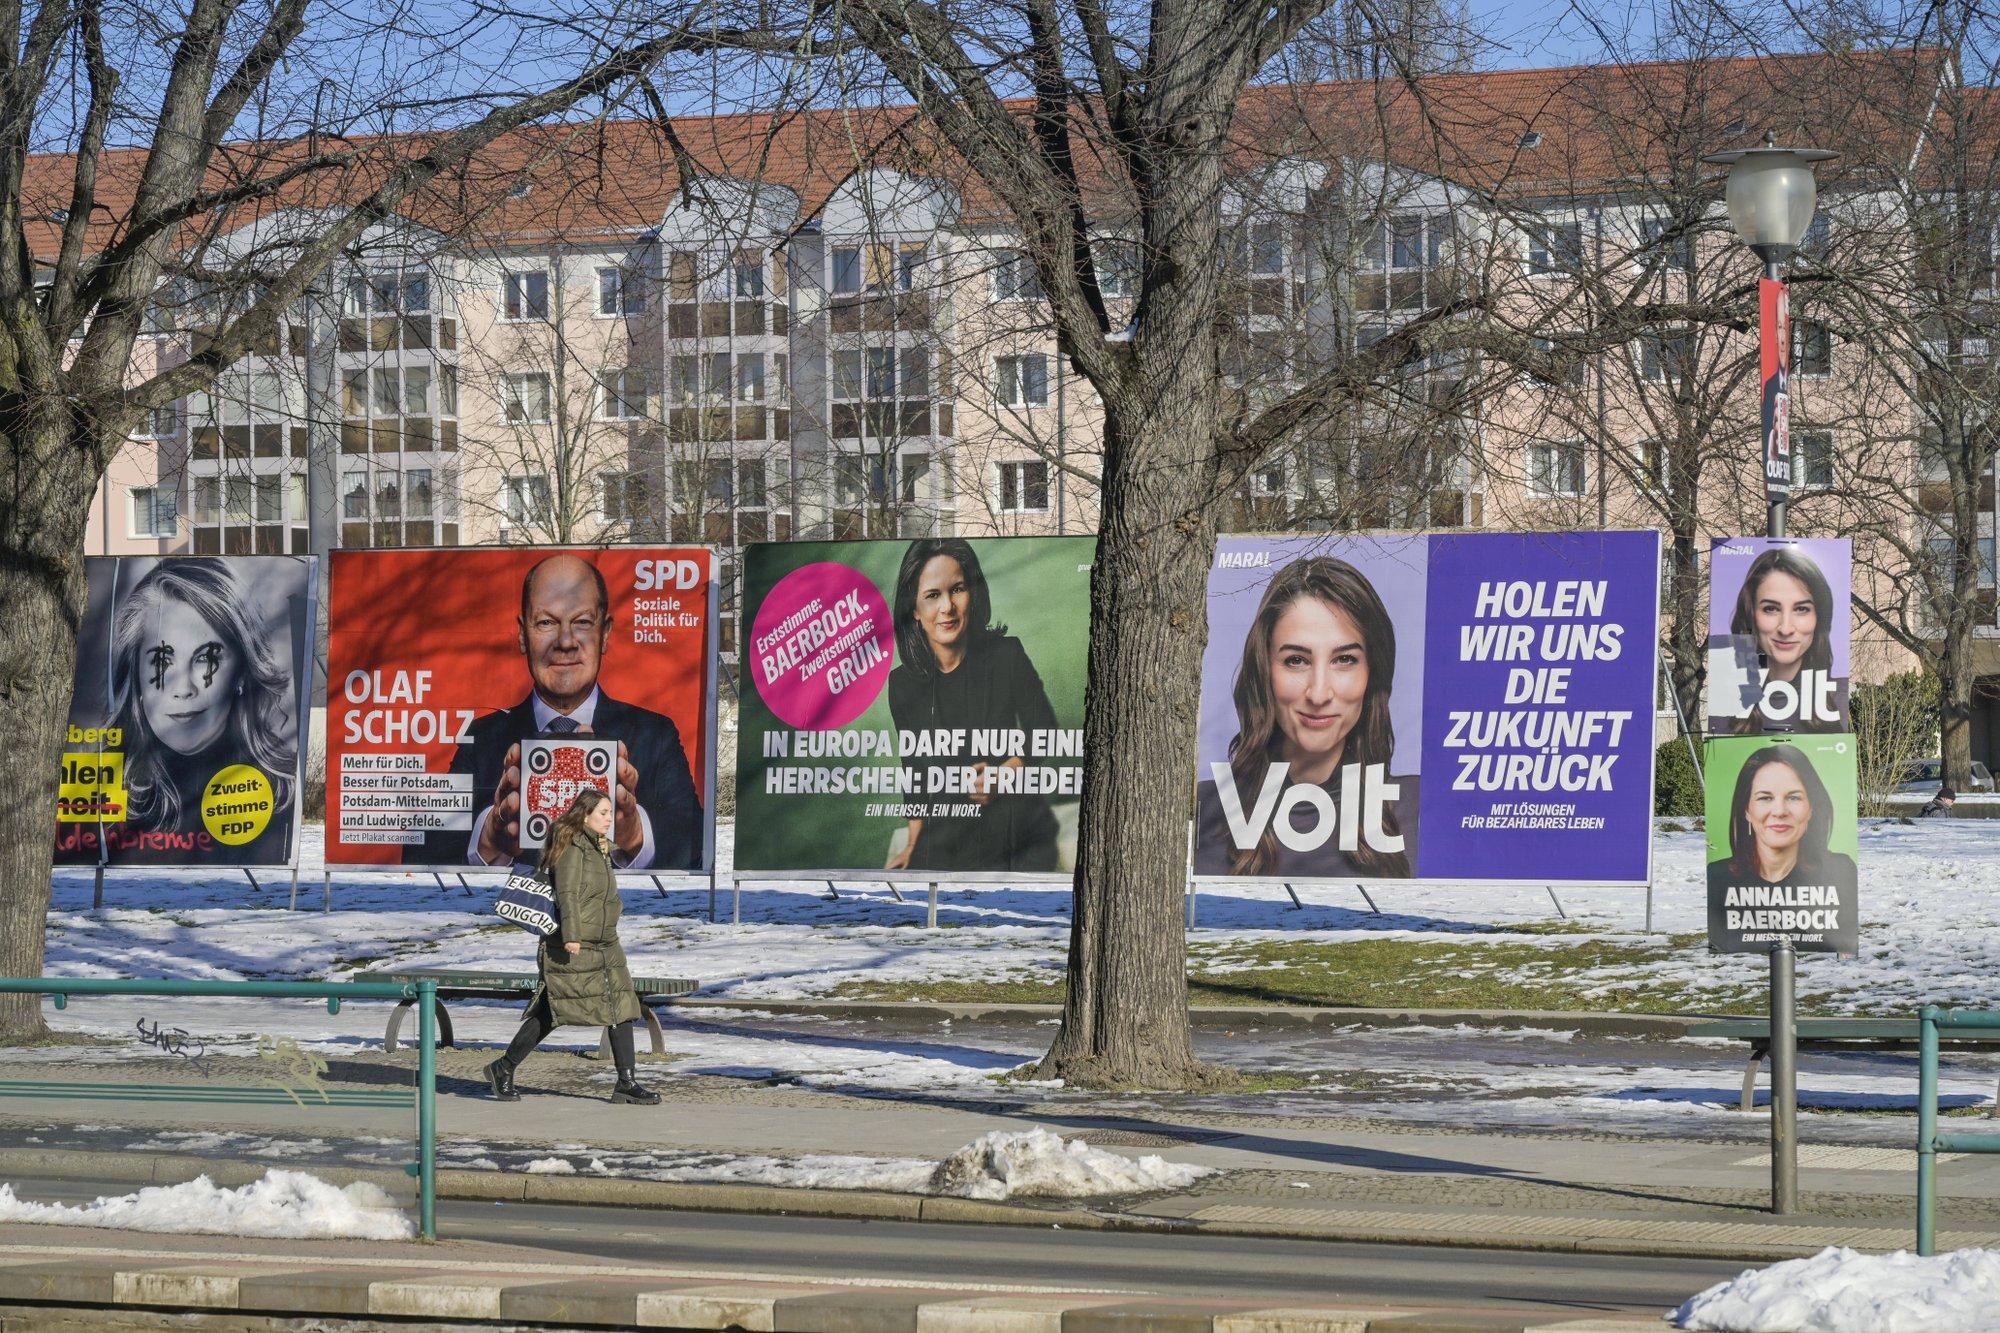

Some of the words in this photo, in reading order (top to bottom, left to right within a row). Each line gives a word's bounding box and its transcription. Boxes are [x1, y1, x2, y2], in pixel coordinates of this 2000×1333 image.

[1720, 545, 1754, 555] MARAL
[634, 560, 700, 591] SPD
[634, 597, 681, 611] Soziale
[1475, 580, 1608, 618] HOLEN
[634, 613, 676, 627] Politik
[679, 612, 699, 627] für
[756, 598, 823, 655] Erststimme:
[634, 629, 667, 643] Dich.
[762, 587, 870, 685] BAERBOCK.
[1460, 625, 1535, 661] WIR
[1540, 623, 1625, 661] UNS
[798, 618, 875, 682] Zweitstimme:
[826, 635, 889, 695] GRÜN.
[344, 669, 432, 704] OLAF
[1504, 668, 1571, 704] DIE
[344, 709, 475, 744] SCHOLZ
[1443, 711, 1633, 748] ZUKUNFT
[763, 731, 788, 757] IN
[794, 730, 893, 757] EUROPA
[900, 729, 965, 756] DARF
[971, 728, 1026, 757] NUR
[343, 757, 373, 769] Mehr
[376, 756, 393, 769] für
[395, 757, 423, 769] Dich.
[1452, 747, 1620, 792] ZURÜCK
[211, 779, 262, 796] Zweit-
[343, 776, 380, 788] Besser
[382, 776, 399, 788] für
[400, 777, 453, 790] Potsdam,
[765, 766, 922, 794] HERRSCHEN:
[927, 766, 979, 794] DER
[206, 801, 269, 817] stimme
[342, 795, 460, 808] Potsdam-Mittelmark
[462, 797, 469, 808] II
[865, 804, 883, 817] EIN
[884, 804, 930, 817] MENSCH.
[931, 804, 949, 817] EIN
[951, 804, 982, 817] WORT.
[1210, 761, 1406, 854] Volt
[1491, 804, 1513, 816] MIT
[1513, 802, 1576, 816] LÖSUNGEN
[221, 822, 255, 836] FDP
[342, 815, 364, 826] und
[366, 815, 445, 831] Ludwigsfelde.
[1461, 815, 1485, 829] FÜR
[1486, 817, 1567, 829] BEZAHLBARES
[1567, 817, 1605, 829] LEBEN
[342, 833, 360, 842] Jetzt
[361, 833, 385, 842] Plakat
[386, 833, 424, 843] scannen!
[1724, 886, 1841, 907] ANNALENA
[1726, 909, 1839, 930] BAERBOCK
[1741, 933, 1755, 942] EIN
[1801, 933, 1824, 942] WORT.
